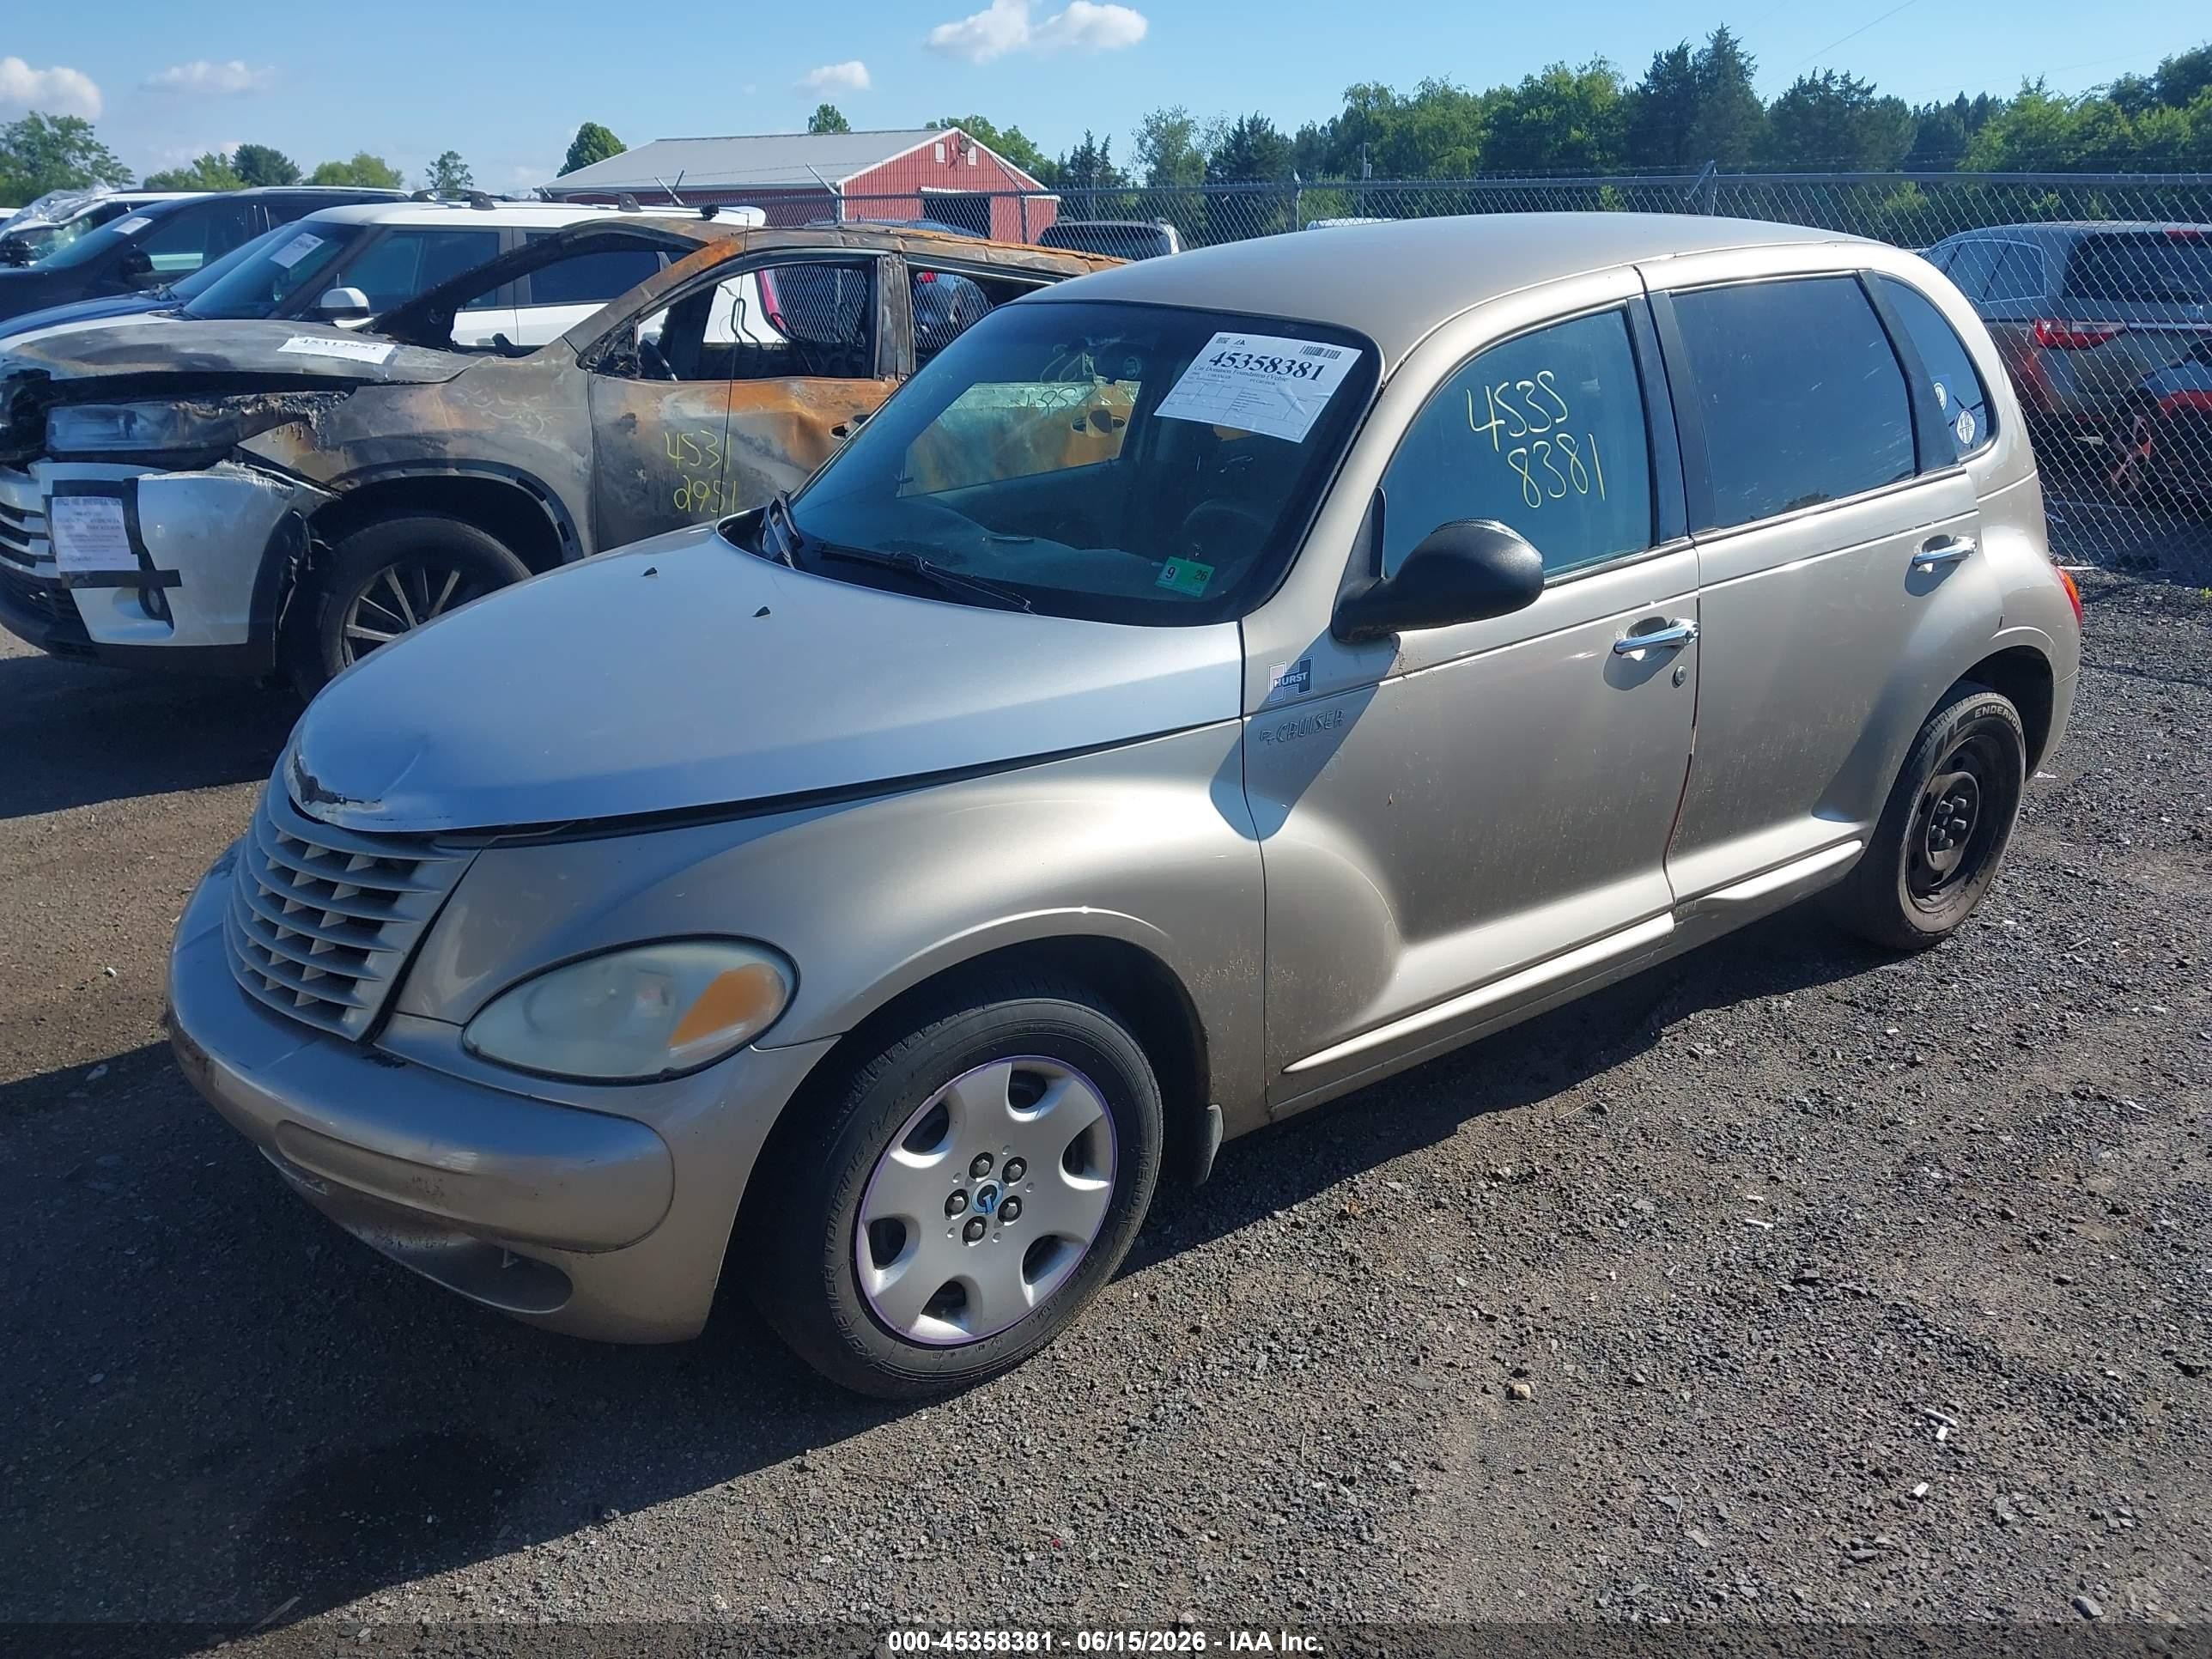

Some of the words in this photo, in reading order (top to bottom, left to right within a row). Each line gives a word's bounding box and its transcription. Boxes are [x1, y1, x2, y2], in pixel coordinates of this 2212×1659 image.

[1208, 350, 1326, 381] 45358381
[665, 429, 731, 473] 4531
[1507, 432, 1607, 508] 8381
[673, 474, 737, 515] 2951
[1165, 566, 1176, 580] 9
[1194, 569, 1209, 582] 26
[1273, 672, 1309, 688] HURST
[1277, 708, 1346, 744] CRUISER
